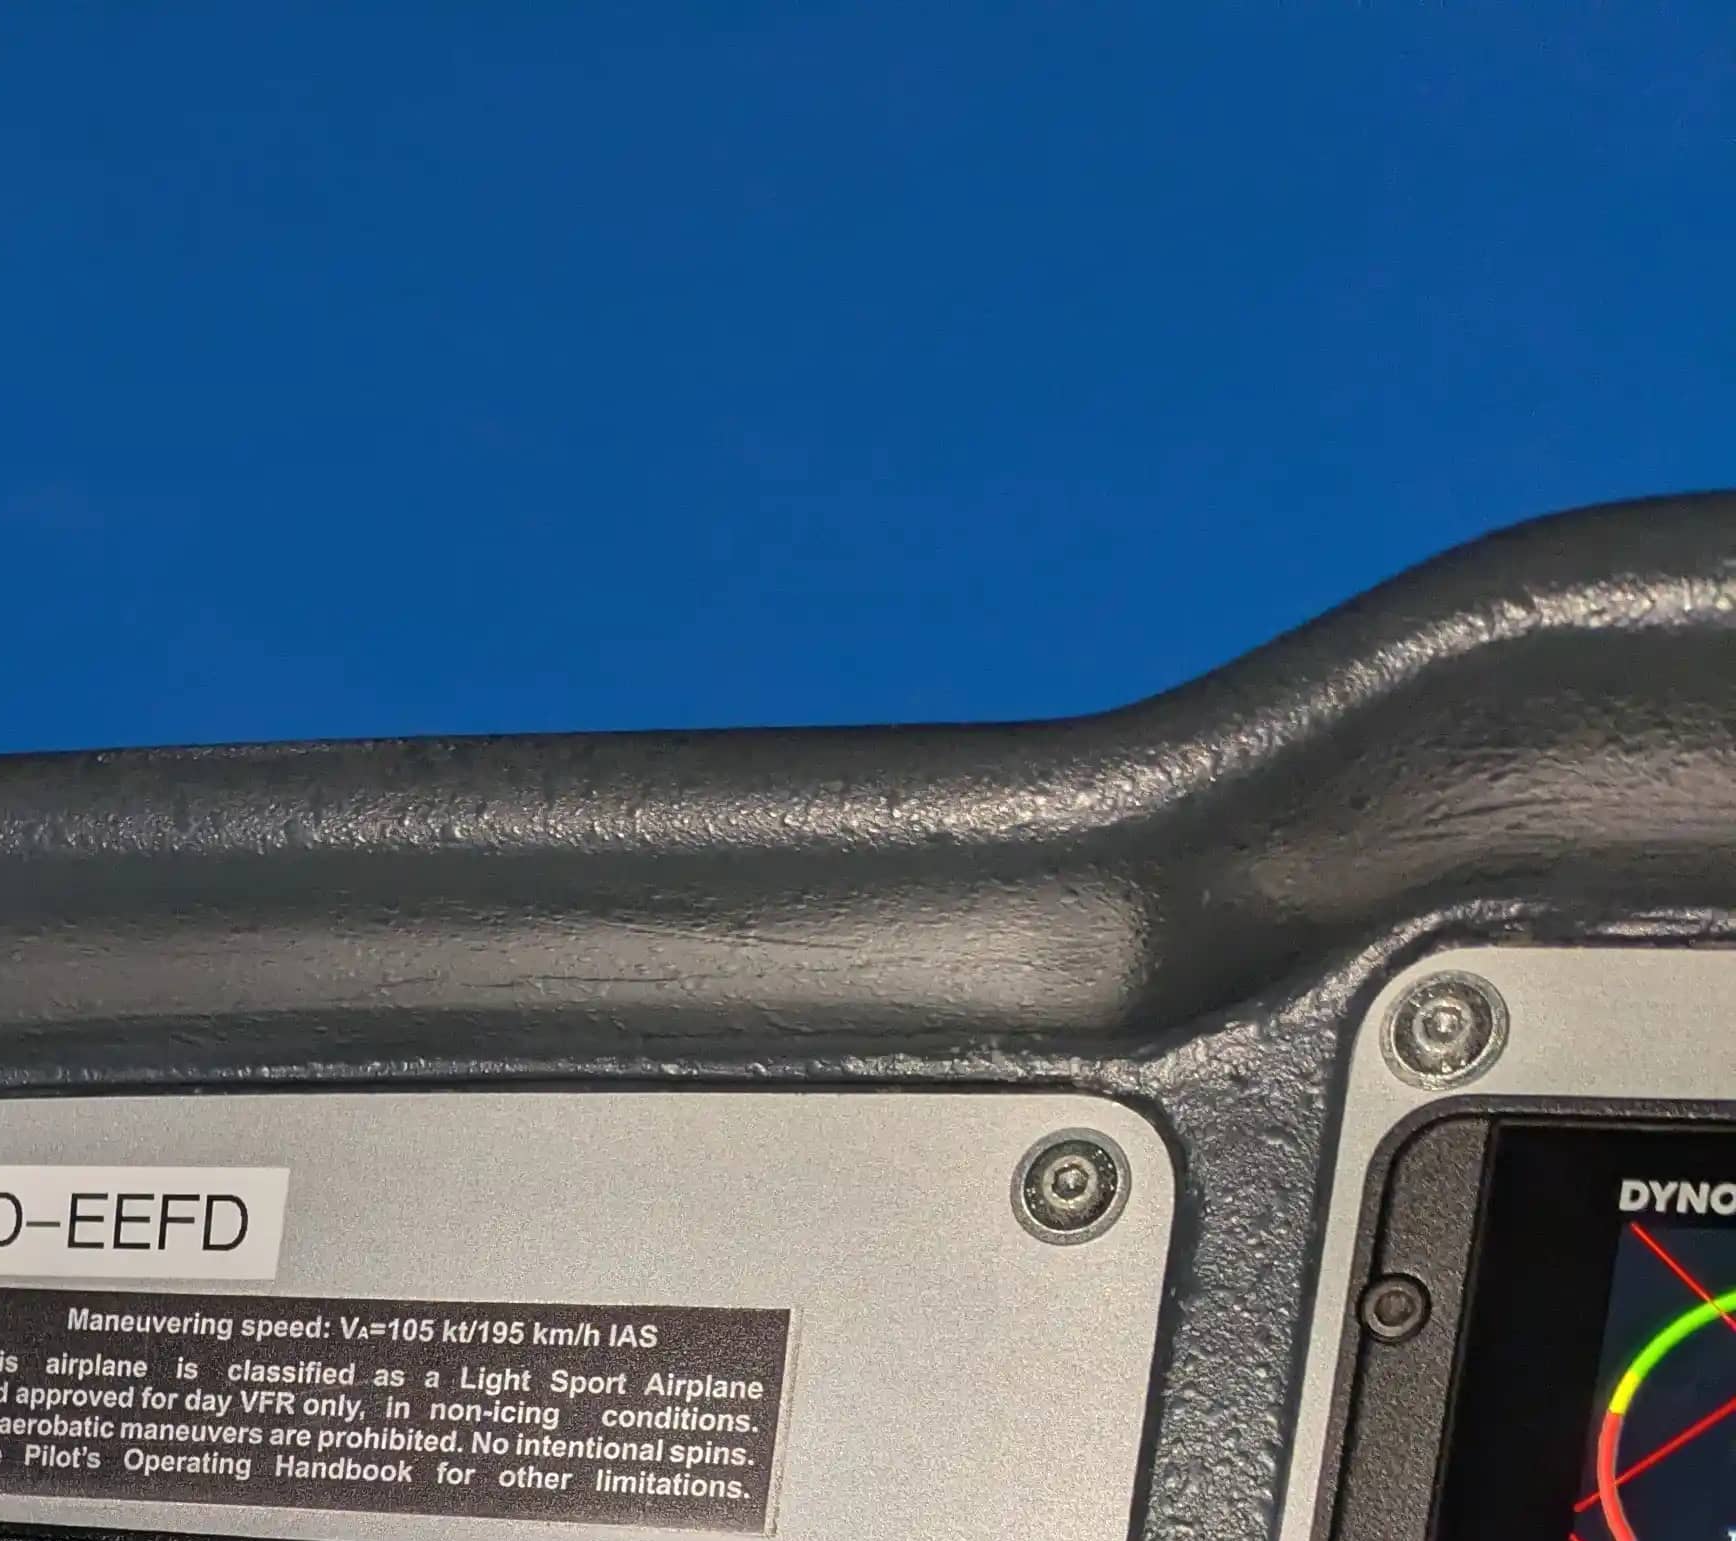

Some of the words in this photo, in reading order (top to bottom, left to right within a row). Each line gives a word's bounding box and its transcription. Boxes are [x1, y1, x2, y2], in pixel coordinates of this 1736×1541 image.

[68, 1308, 233, 1340] Maneuvering
[240, 1316, 330, 1342] speed:
[442, 1320, 525, 1346] kt/195
[533, 1322, 600, 1346] km/h
[609, 1324, 658, 1348] IAS
[45, 1353, 148, 1380] airplane
[176, 1357, 198, 1380] is
[228, 1360, 355, 1385] classified
[373, 1369, 405, 1387] as
[424, 1370, 439, 1388] a
[460, 1366, 532, 1396] Light
[550, 1370, 626, 1398] Sport
[644, 1373, 764, 1403] Airplane
[16, 1387, 134, 1410] approved
[142, 1387, 178, 1410] for
[185, 1389, 232, 1417] day
[240, 1391, 296, 1415] VFR
[303, 1395, 365, 1422] only,
[386, 1396, 410, 1418] in
[430, 1400, 560, 1429] non-icing
[602, 1407, 758, 1433] conditions.
[120, 1421, 263, 1445] maneuvers
[270, 1428, 311, 1447] are
[318, 1427, 463, 1453] prohibited.
[472, 1431, 509, 1455] No
[516, 1434, 664, 1462] intentional
[669, 1442, 755, 1469] spins.
[124, 1448, 251, 1480] Operating
[275, 1455, 413, 1483] Handbook
[437, 1462, 475, 1485] for
[499, 1466, 573, 1490] other
[596, 1469, 750, 1499] limitations.
